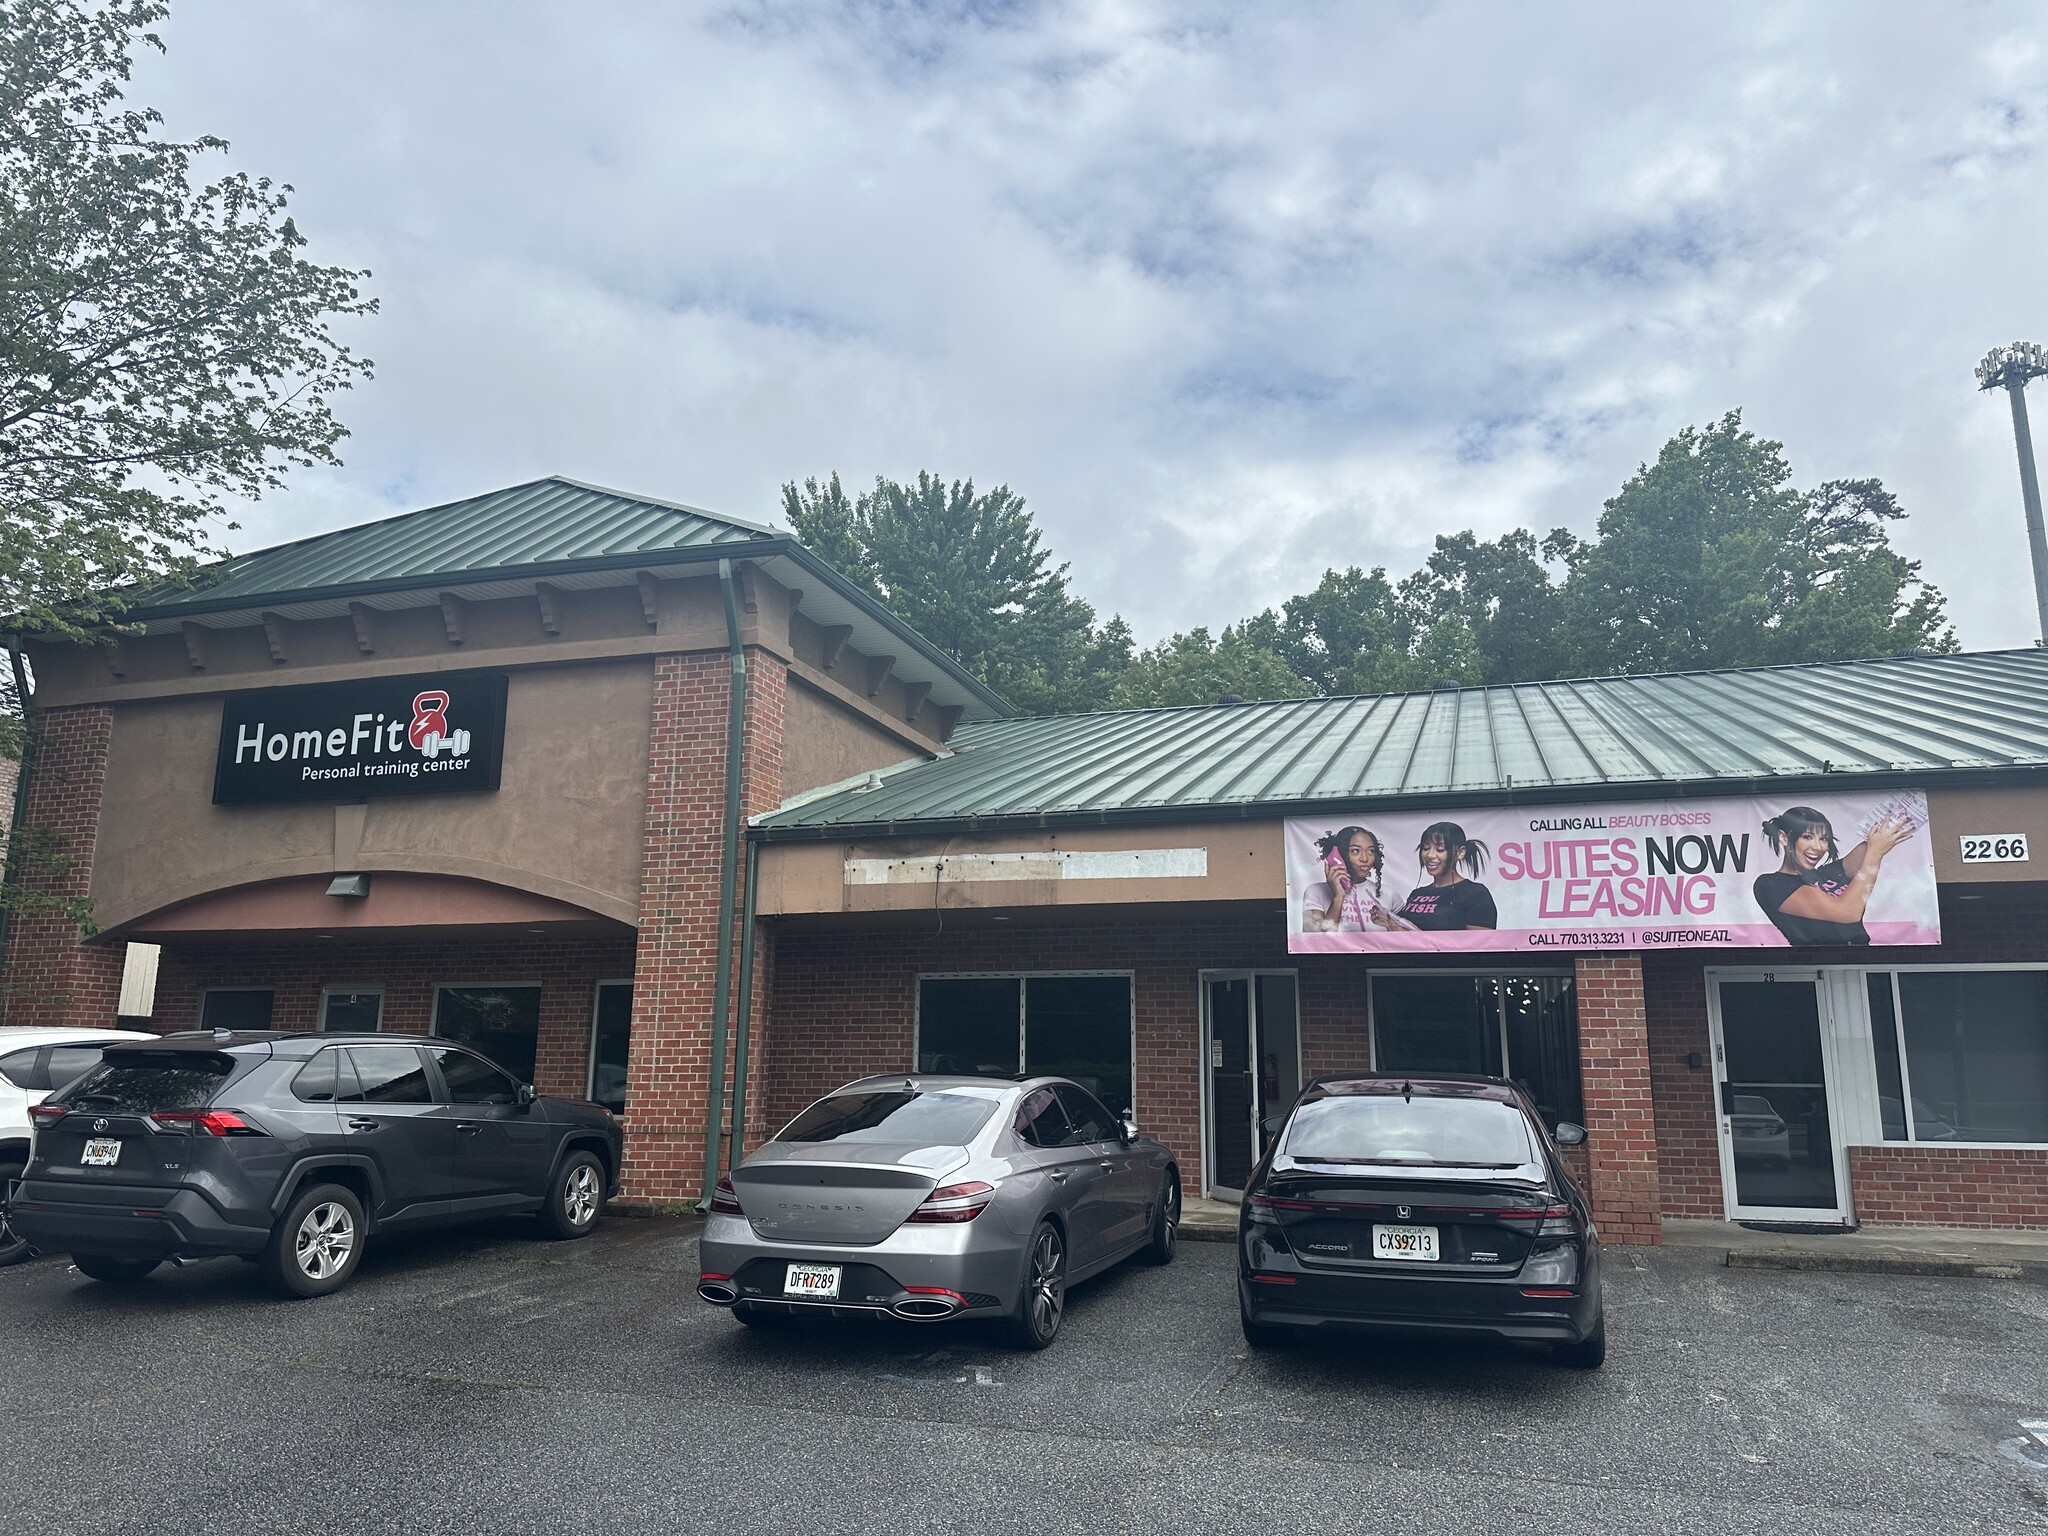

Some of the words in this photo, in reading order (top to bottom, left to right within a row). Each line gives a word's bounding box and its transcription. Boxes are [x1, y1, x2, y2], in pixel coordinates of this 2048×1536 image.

[235, 713, 404, 764] HomeFit
[302, 762, 360, 781] Personal
[364, 759, 418, 778] training
[422, 757, 471, 772] center
[1530, 818, 1582, 832] CALLING
[1583, 817, 1607, 829] ALL
[1608, 815, 1659, 828] BEAUTY
[1660, 812, 1711, 826] BOSSES
[1498, 837, 1639, 881] SUITES
[1645, 833, 1750, 876] NOW
[1963, 839, 2025, 859] 2266
[1538, 875, 1717, 919] LEASING
[1529, 933, 1558, 945] CALL
[1560, 932, 1625, 945] 770.313.3231
[1642, 930, 1732, 944] @SUITEONEATL
[1387, 1226, 1422, 1235] GEORGIA
[1308, 1243, 1348, 1251] ACCORD
[1380, 1233, 1432, 1251] CXS9213
[790, 1271, 834, 1289] DFR7289
